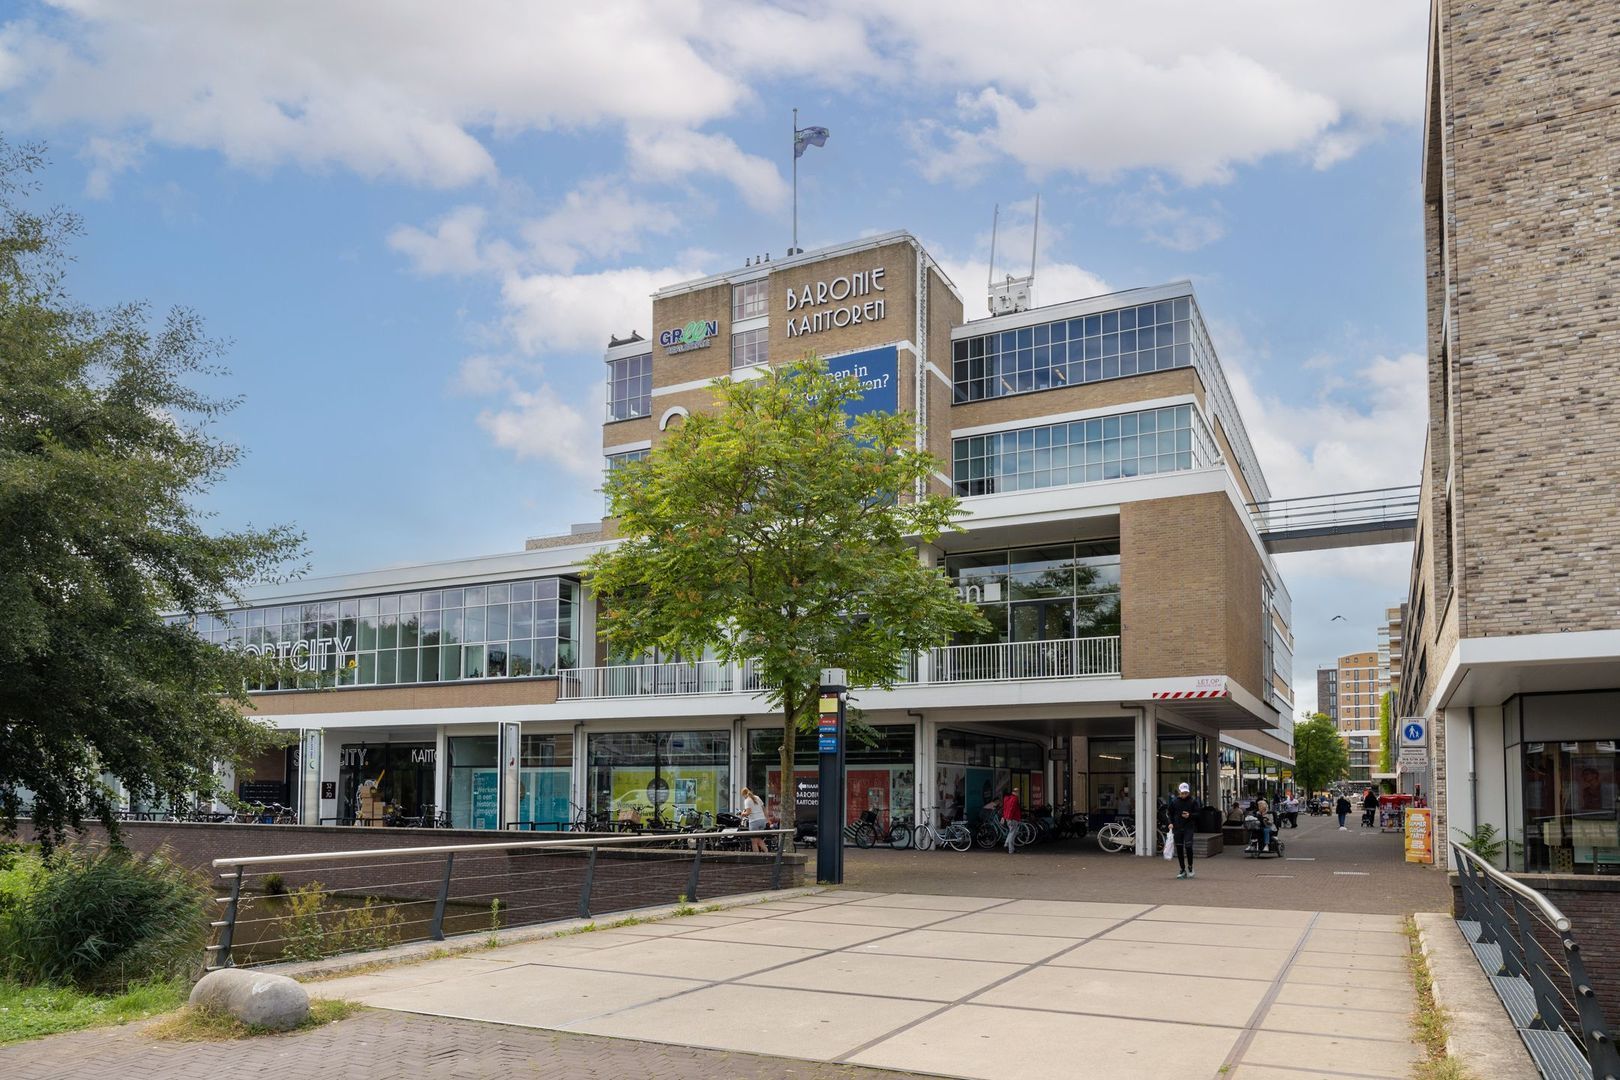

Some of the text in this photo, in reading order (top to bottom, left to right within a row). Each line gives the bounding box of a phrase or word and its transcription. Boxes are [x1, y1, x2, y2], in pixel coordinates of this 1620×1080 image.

[787, 267, 885, 311] BARONIE
[787, 299, 885, 338] KANTOREN
[854, 364, 868, 377] in
